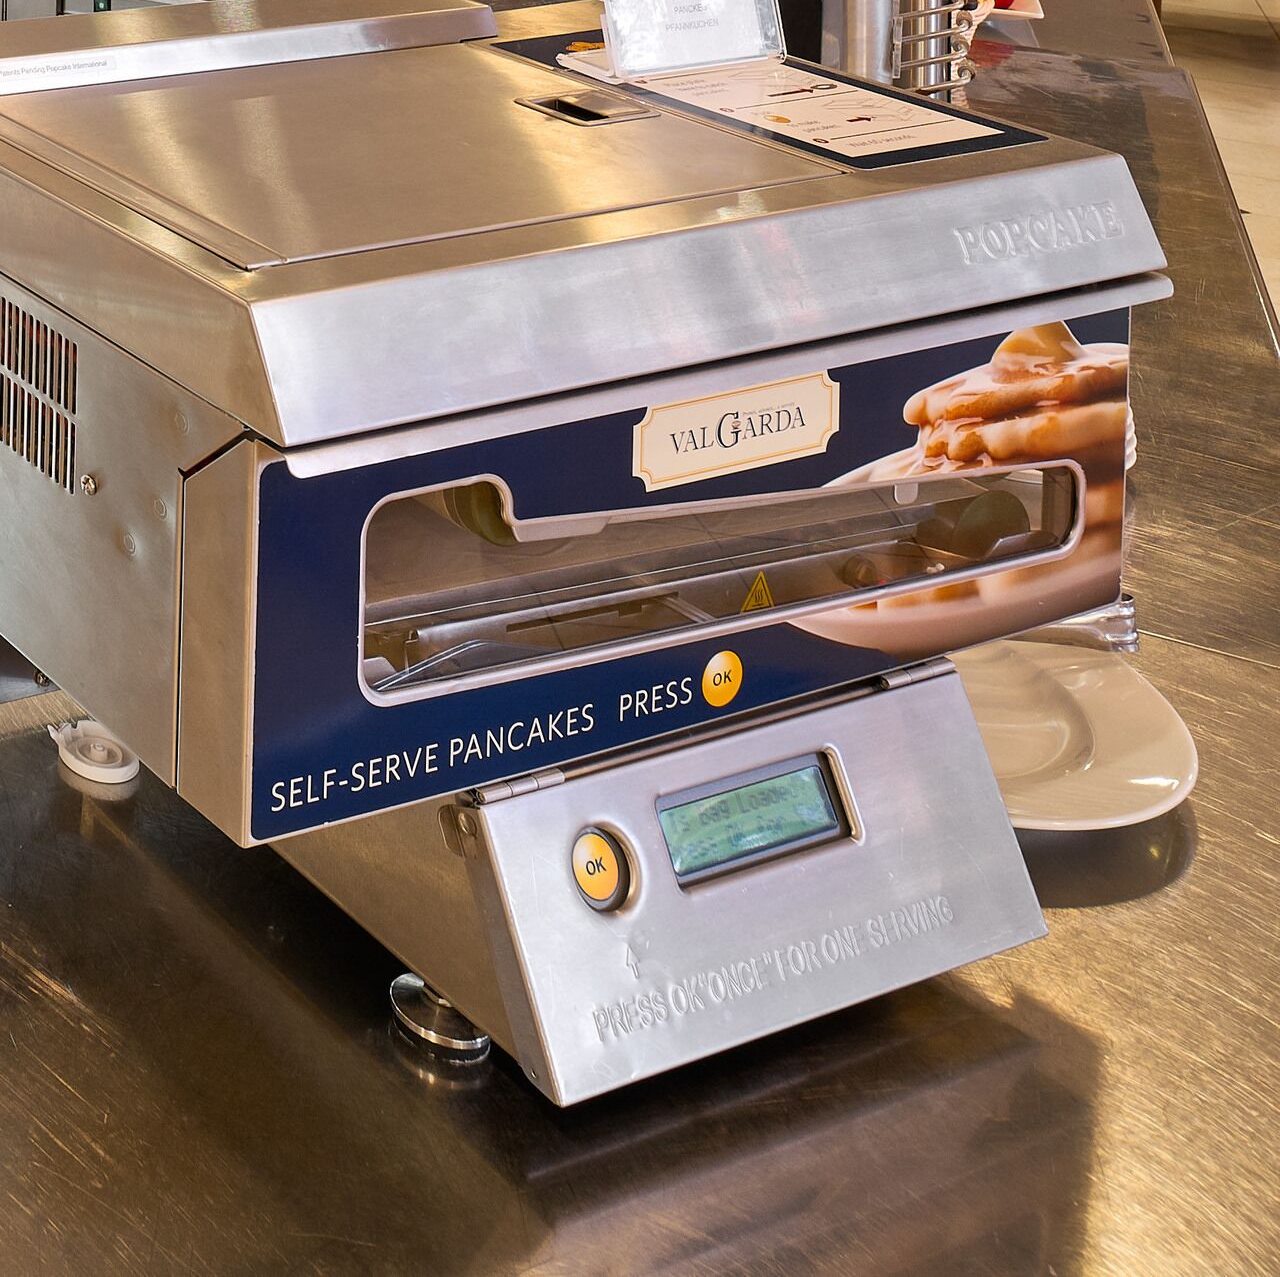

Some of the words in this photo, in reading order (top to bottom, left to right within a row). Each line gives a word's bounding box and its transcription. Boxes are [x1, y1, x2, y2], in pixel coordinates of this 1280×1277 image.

[21, 66, 45, 74] Pending
[952, 201, 1128, 266] POPCAKE
[271, 743, 439, 813] SELF-SERVE
[449, 703, 595, 768] PANCAKES
[618, 676, 693, 722] PRESS
[711, 669, 733, 687] OK
[585, 857, 607, 876] OK
[591, 989, 669, 1042] PRESS
[773, 939, 822, 982] FOR
[821, 924, 863, 963] ONE
[866, 895, 955, 949] SERVING
